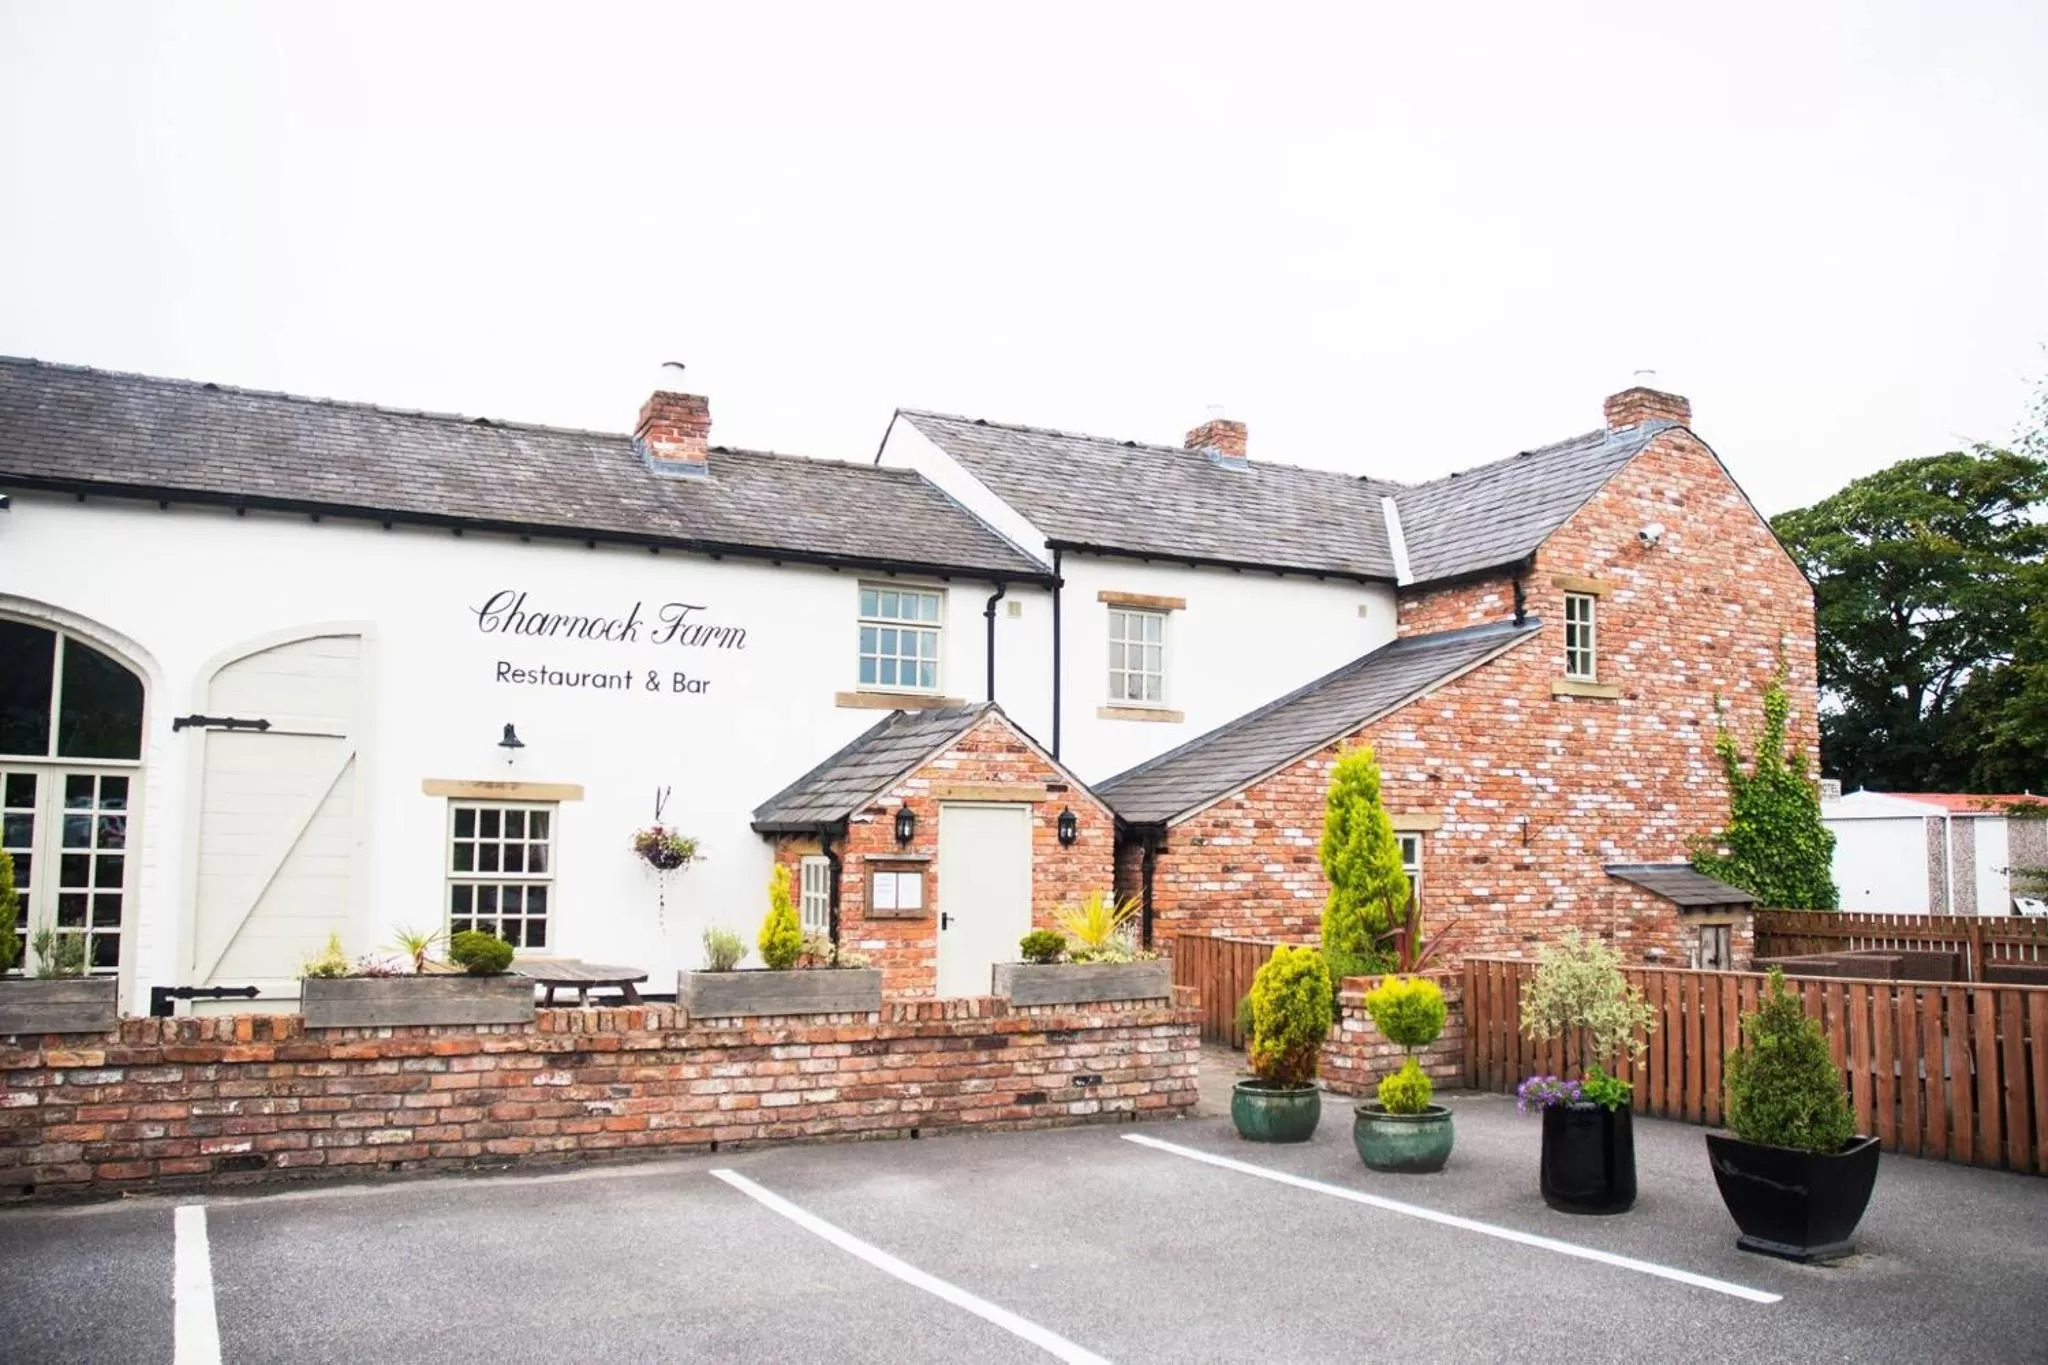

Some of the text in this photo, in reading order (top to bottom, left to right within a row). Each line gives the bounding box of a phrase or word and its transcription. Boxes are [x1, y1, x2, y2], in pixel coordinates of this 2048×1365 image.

[470, 589, 748, 651] Charnock Farm
[496, 661, 711, 694] Restaurant & Bar
